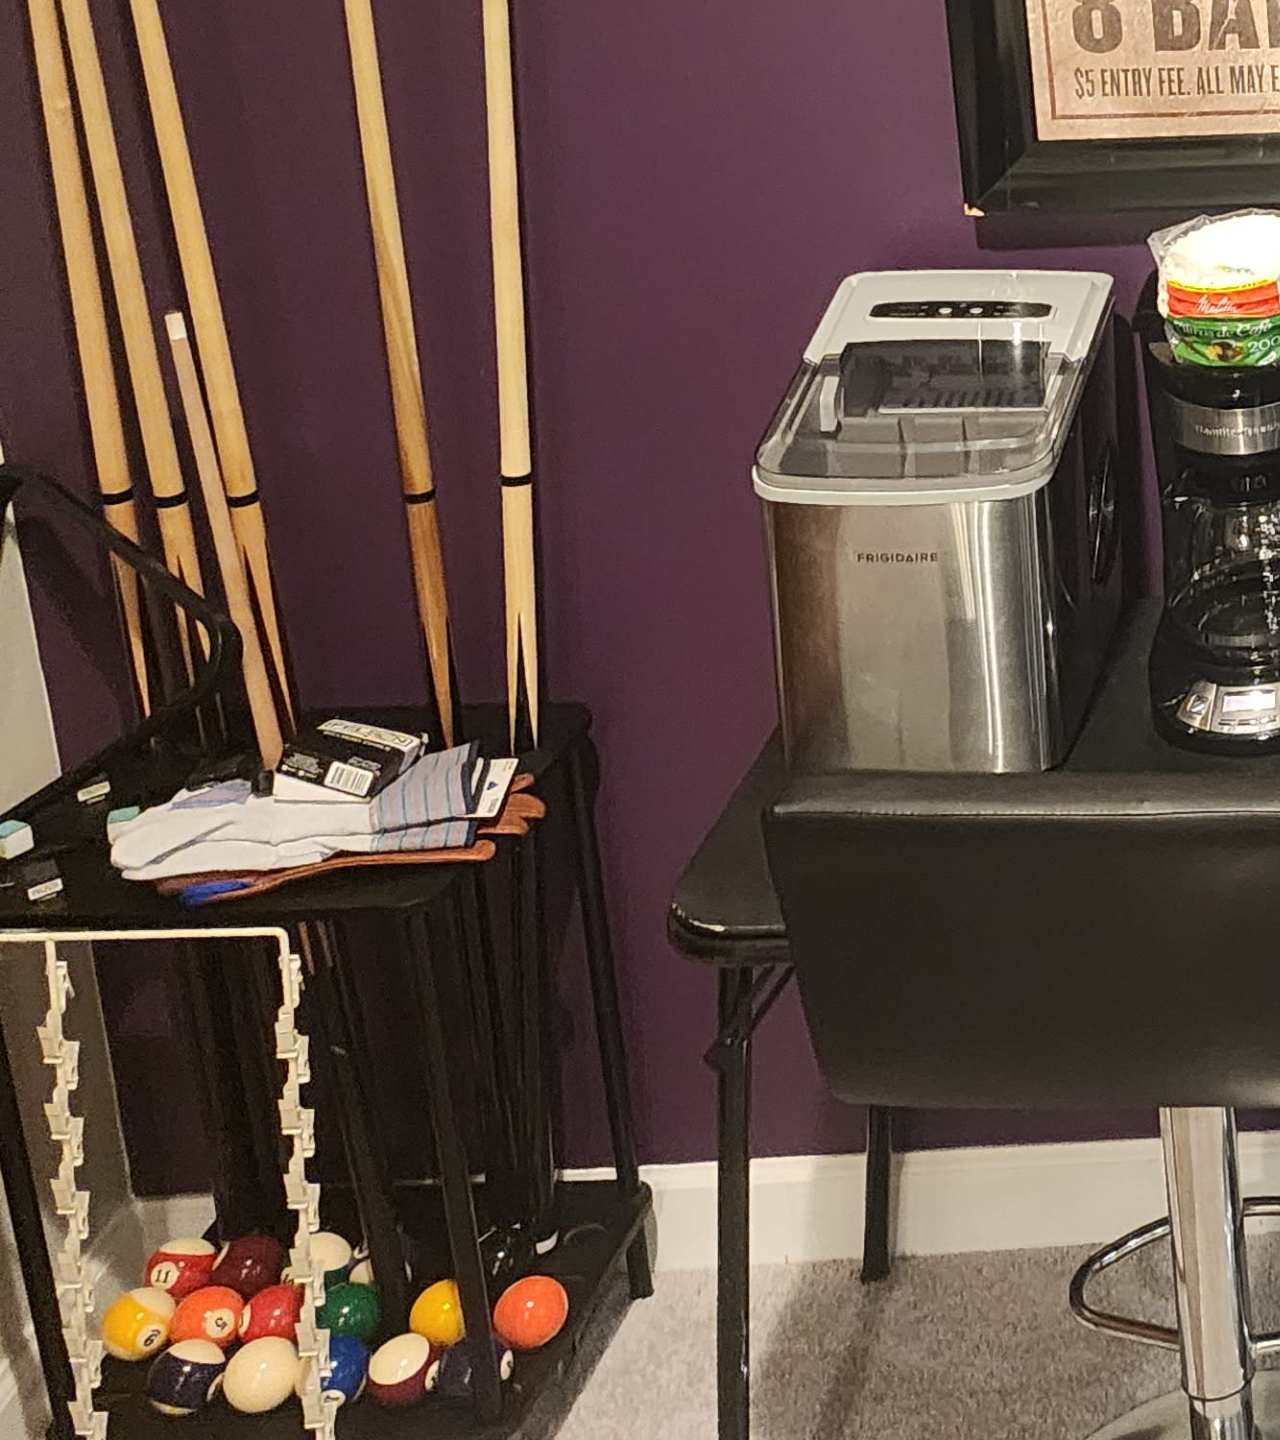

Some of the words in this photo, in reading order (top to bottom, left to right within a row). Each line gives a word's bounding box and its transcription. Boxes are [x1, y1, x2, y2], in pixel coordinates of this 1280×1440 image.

[1073, 67, 1096, 99] $5
[1102, 67, 1152, 97] ENTRY
[1158, 66, 1191, 96] FEE.
[1197, 65, 1224, 95] ALL
[1230, 63, 1265, 94] MAY
[1248, 336, 1280, 351] 200
[857, 551, 938, 563] FRIGIDAIRE
[154, 1268, 170, 1284] 11
